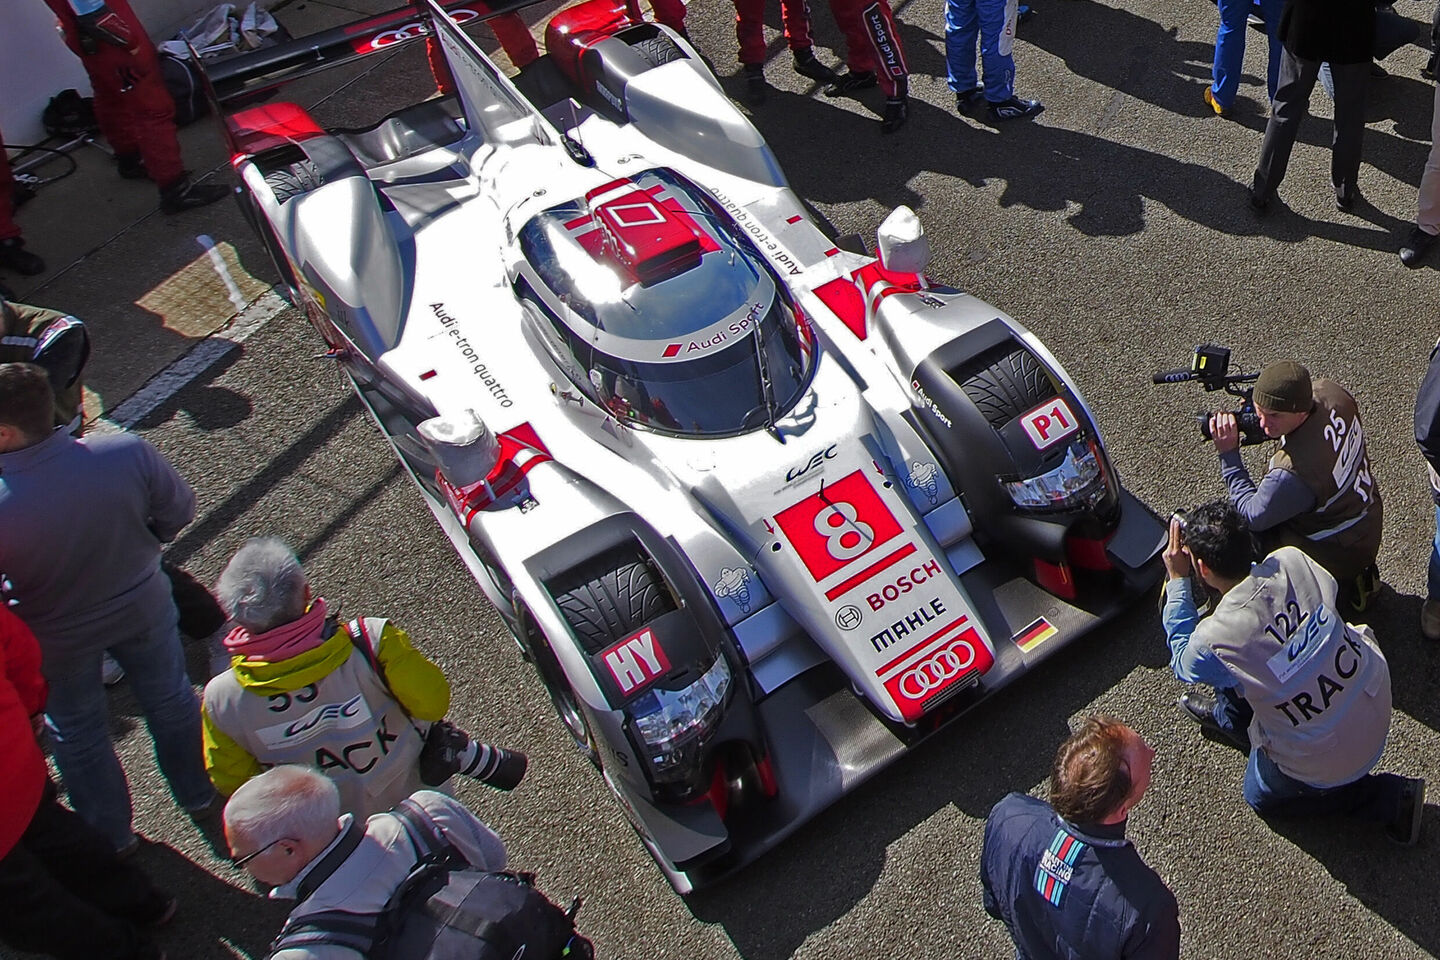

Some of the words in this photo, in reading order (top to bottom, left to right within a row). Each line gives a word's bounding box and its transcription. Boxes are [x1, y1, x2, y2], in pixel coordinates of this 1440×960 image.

[872, 14, 887, 43] Sport
[880, 42, 896, 65] Audi
[709, 186, 749, 223] quattro
[744, 216, 778, 252] e-tron
[774, 248, 804, 276] Audi
[686, 330, 727, 354] Audi
[728, 301, 765, 336] Sport
[428, 302, 459, 328] Audi
[448, 328, 480, 364] e-tron
[473, 363, 514, 409] quattro
[917, 388, 933, 409] Audi
[931, 403, 952, 429] Sport
[1031, 406, 1071, 441] P1
[1323, 408, 1347, 453] 25
[785, 443, 838, 483] WEC
[1353, 456, 1373, 503] TV
[813, 501, 876, 561] 8
[866, 559, 942, 613] BOSCH
[870, 596, 948, 654] MAHLE
[1264, 600, 1309, 645] 122
[1287, 603, 1329, 662] WEC
[604, 630, 663, 693] HY
[1274, 625, 1363, 727] TRACK
[284, 692, 363, 738] WEC
[1041, 856, 1072, 881] RACING
